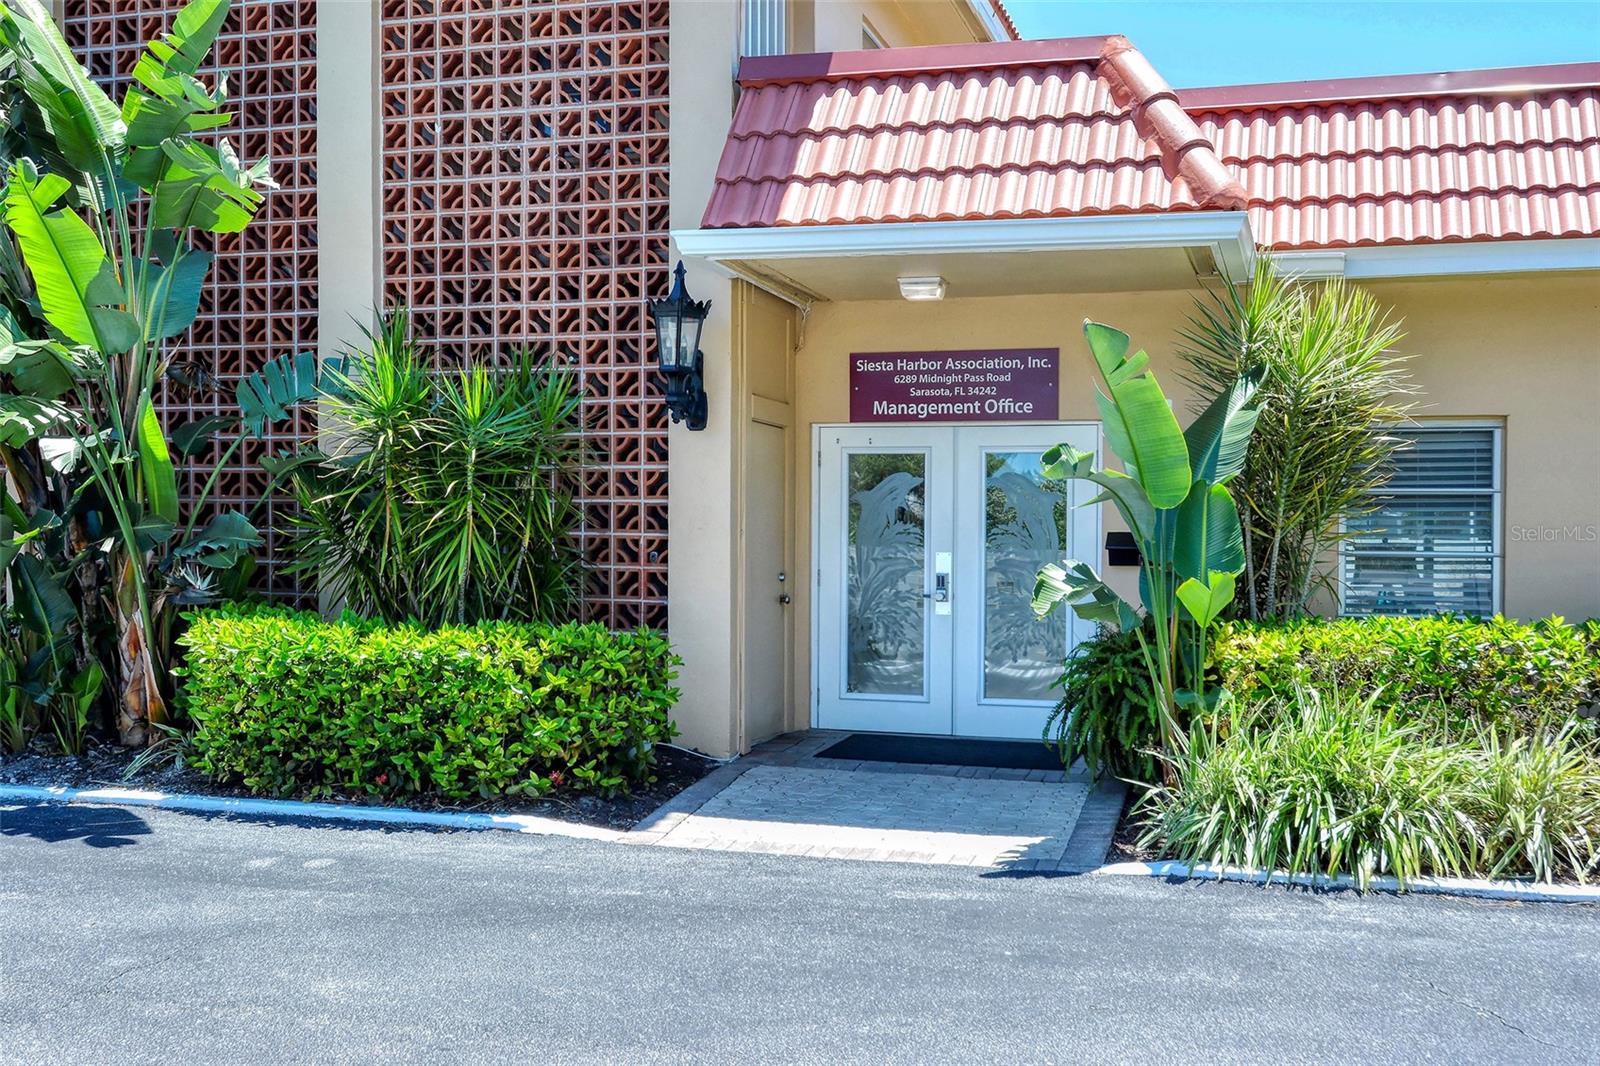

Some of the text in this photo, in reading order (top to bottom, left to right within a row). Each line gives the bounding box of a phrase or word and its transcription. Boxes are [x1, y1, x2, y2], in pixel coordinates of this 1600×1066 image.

[856, 356, 1051, 371] Siesta Harbor Association, Inc.
[894, 373, 1011, 385] 6289 Midnight Pass Road
[910, 386, 997, 397] Sarasota, FL 34242
[873, 398, 1033, 418] Management Office
